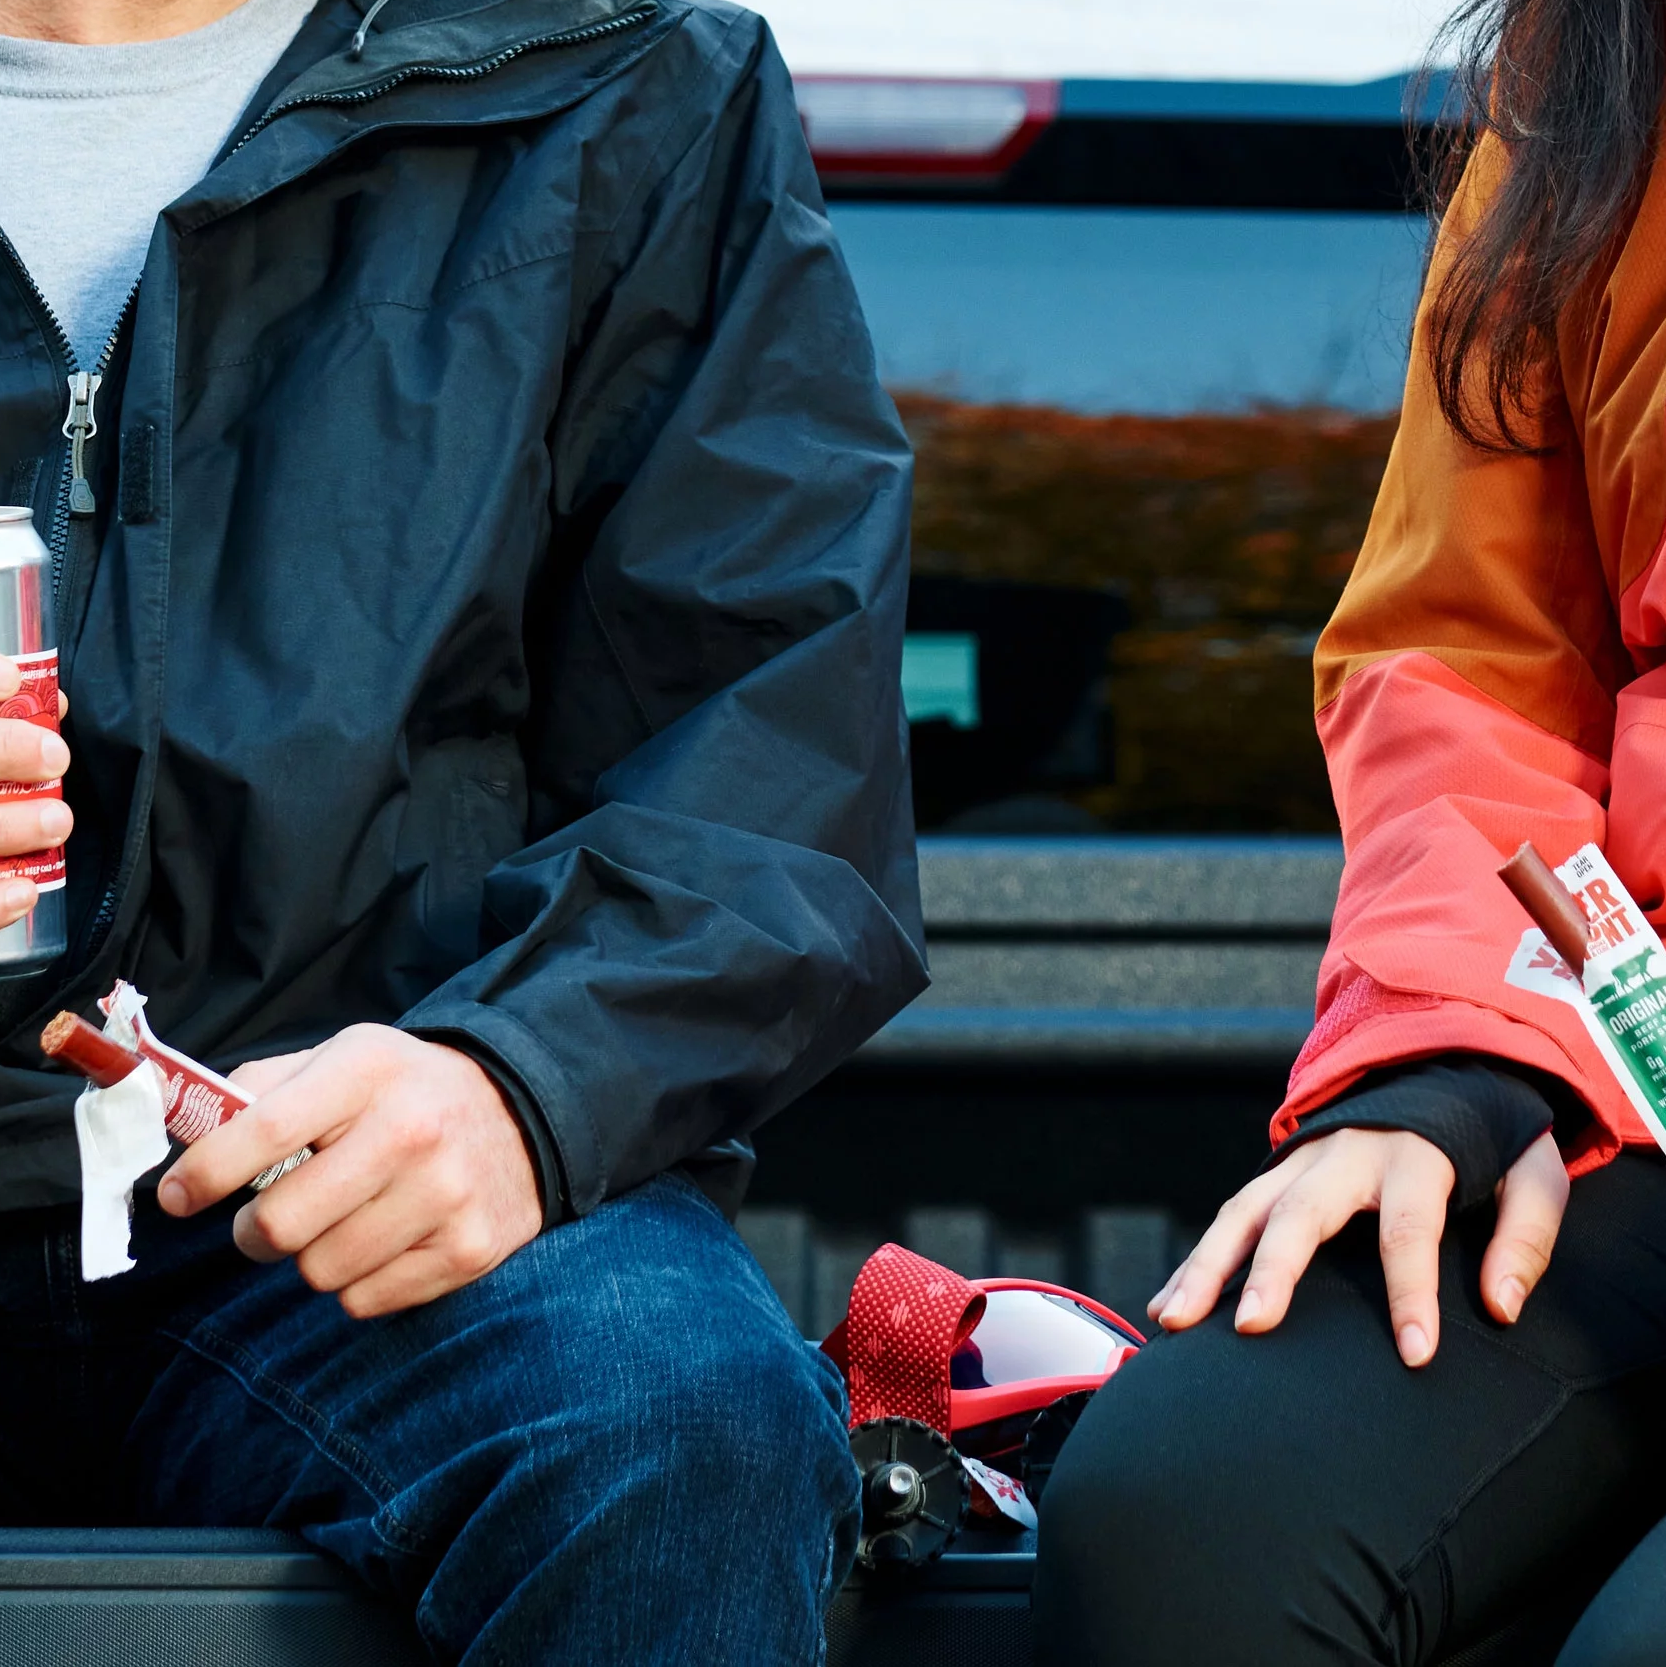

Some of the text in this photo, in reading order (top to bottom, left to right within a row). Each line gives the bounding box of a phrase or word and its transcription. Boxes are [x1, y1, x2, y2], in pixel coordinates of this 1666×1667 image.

[1572, 855, 1589, 871] TEAR
[1576, 862, 1594, 878] OPEN
[1634, 1017, 1660, 1038] BEEF
[1630, 1033, 1656, 1053] PORK
